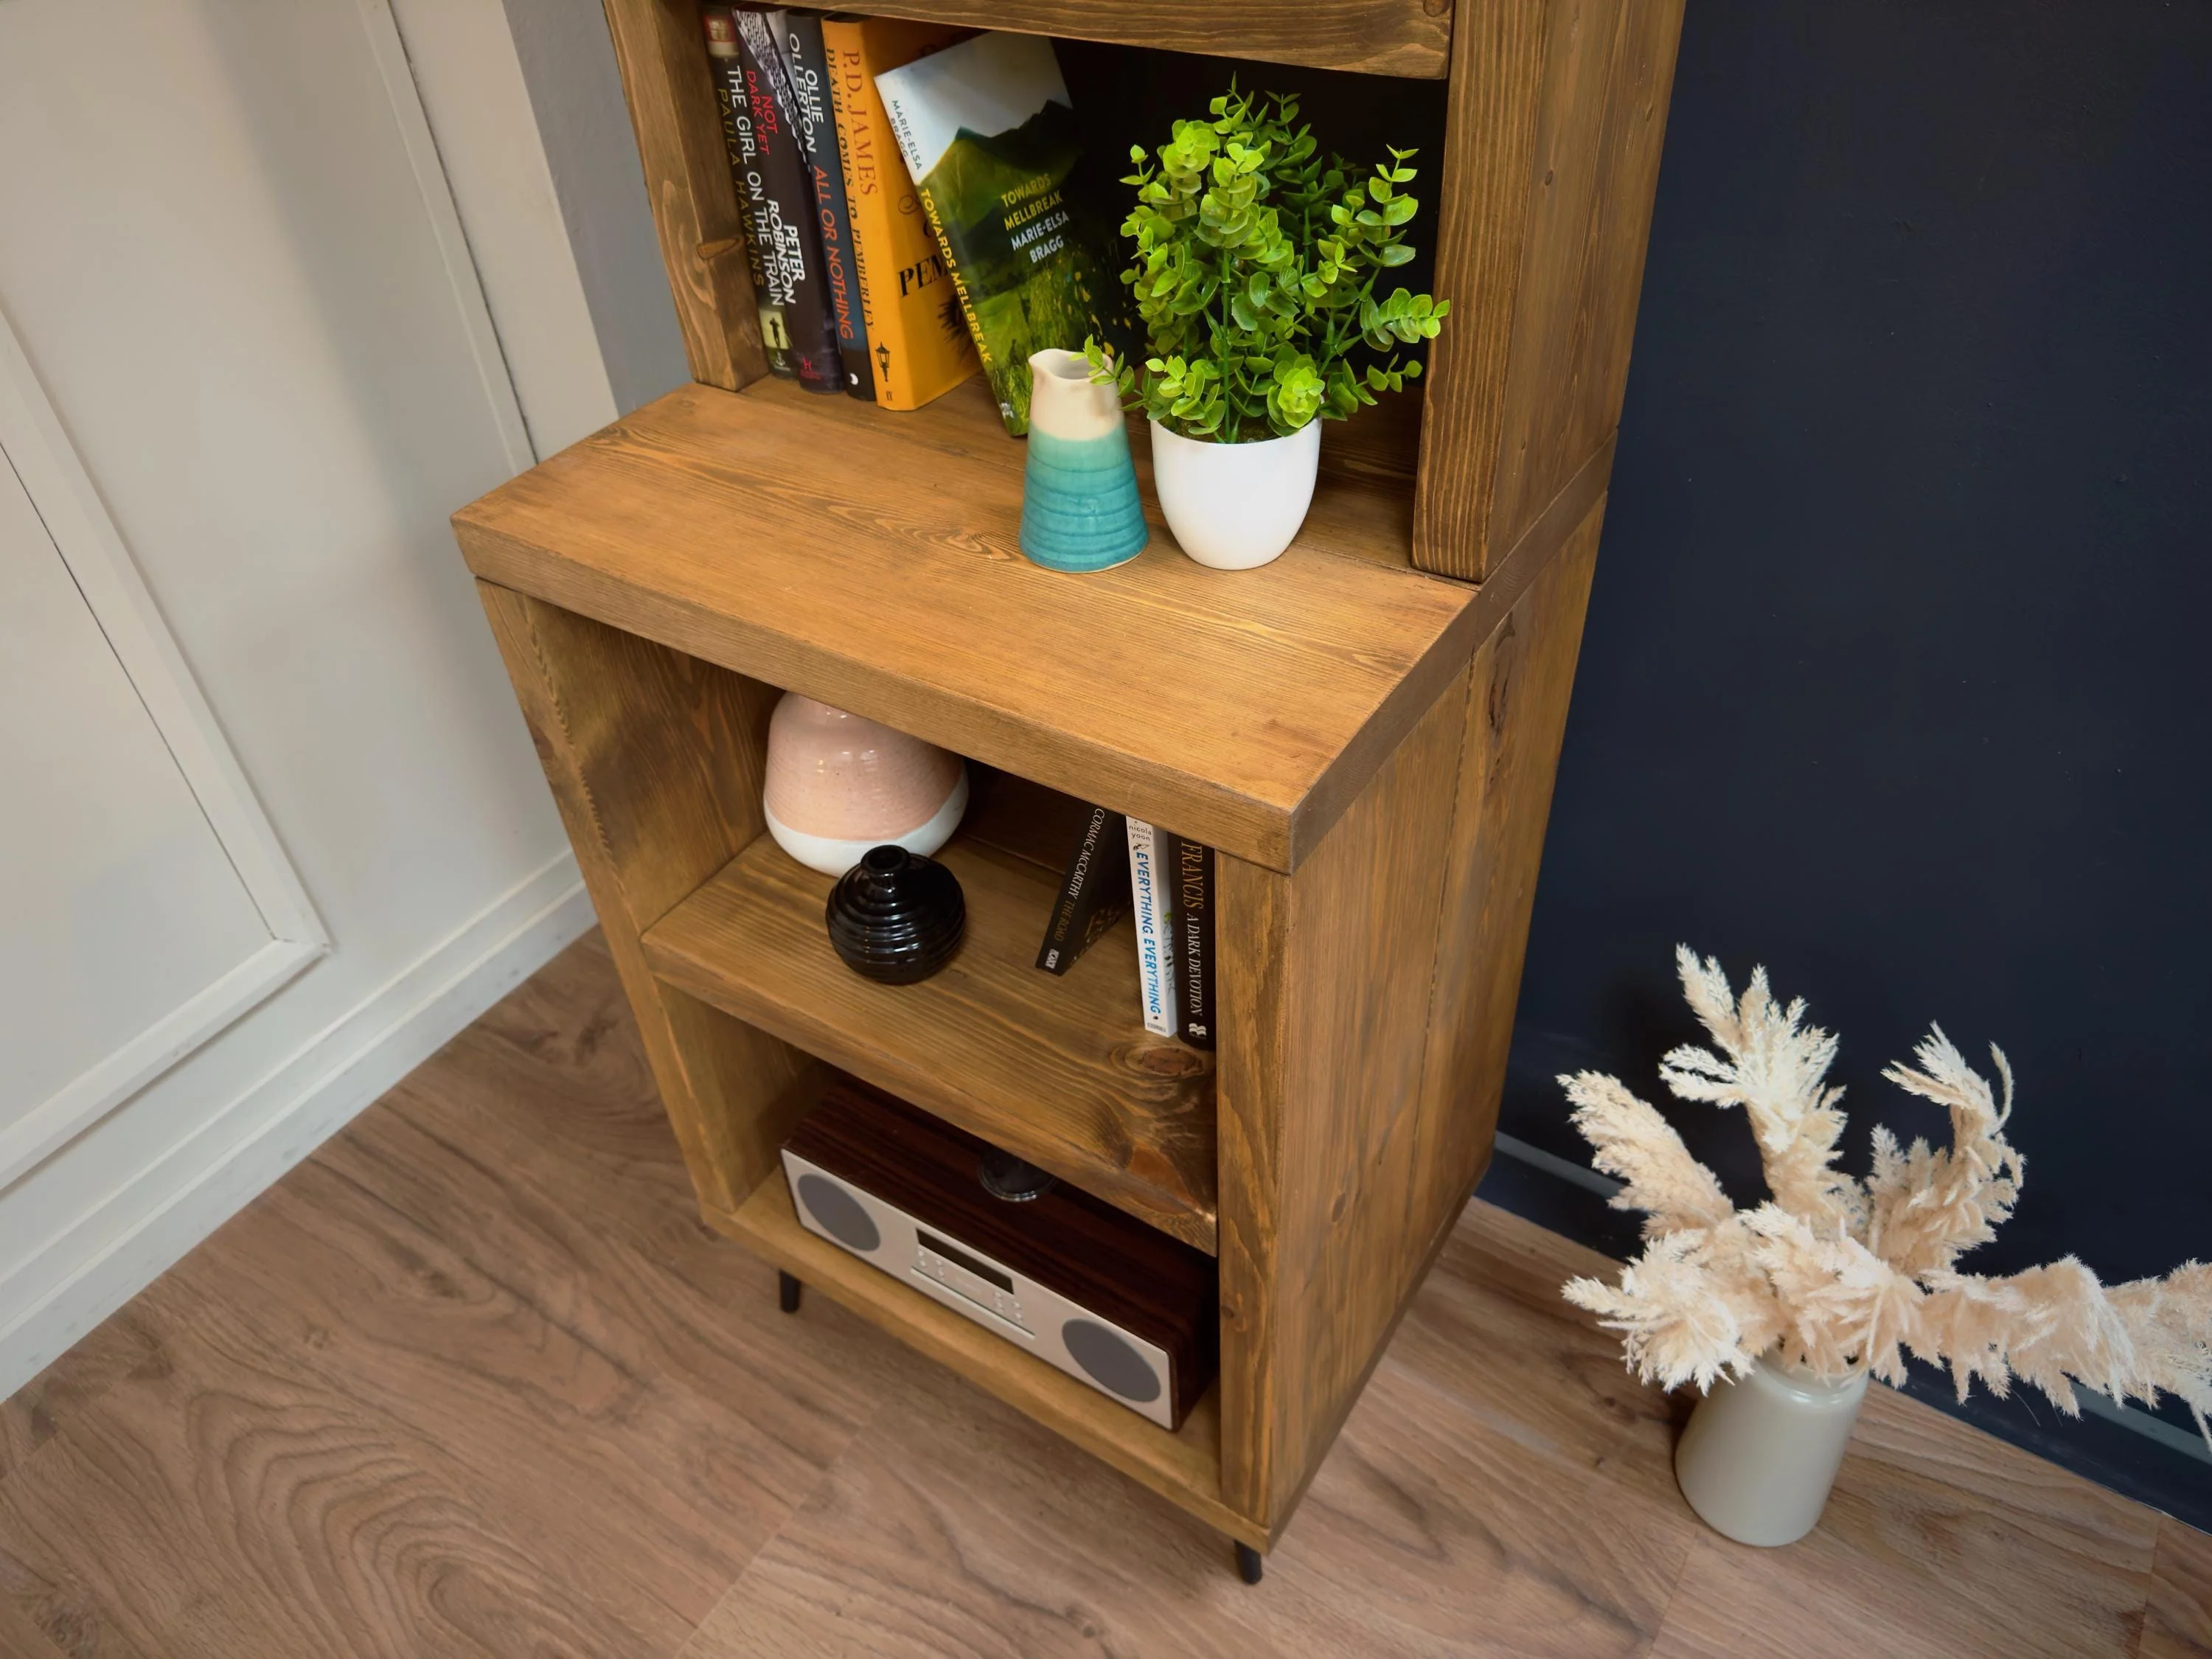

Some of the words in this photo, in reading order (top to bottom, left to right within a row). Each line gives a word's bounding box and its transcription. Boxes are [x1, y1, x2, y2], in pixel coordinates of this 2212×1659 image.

[727, 65, 748, 108] THE
[789, 32, 817, 153] OLLERTON
[804, 69, 825, 124] OLLIE
[745, 70, 764, 118] DARK
[756, 123, 770, 156] YET
[760, 94, 779, 133] NOT
[826, 48, 844, 114] DEATH
[837, 123, 855, 187] COMES
[847, 194, 858, 220] TO
[736, 116, 757, 164] GIRL
[847, 103, 878, 196] JAMES
[890, 117, 909, 157] BRAGG
[891, 100, 922, 170] MARIE-ELSA
[717, 88, 741, 165] PAULA
[734, 181, 765, 286] HAWKINS
[747, 171, 765, 201] ON
[813, 165, 832, 204] ALL
[1001, 173, 1051, 208] TOWARDS
[754, 207, 773, 247] THE
[821, 209, 838, 242] OR
[1004, 189, 1063, 231] MELLBREAK
[1010, 210, 1069, 251] MARIE-ELSA
[767, 198, 796, 305] ROBINSON
[783, 223, 806, 282] PETER
[1029, 234, 1065, 263] BRAGG
[762, 251, 785, 306] TRAIN
[827, 248, 854, 339] NOTHING
[920, 188, 956, 268] TOWARDS
[950, 271, 993, 363] MELLBREAK
[1083, 808, 1105, 851] CORMAC
[1128, 821, 1152, 835] nicola
[1131, 832, 1151, 841] yoon
[1181, 841, 1204, 909] FRANCIS
[1054, 917, 1069, 942] ROAD
[1062, 900, 1077, 919] THE
[1186, 912, 1200, 922] A
[1187, 924, 1201, 957] DARK
[1144, 937, 1161, 1015] EVERYTHING
[1189, 958, 1203, 1015] DEVOTION
